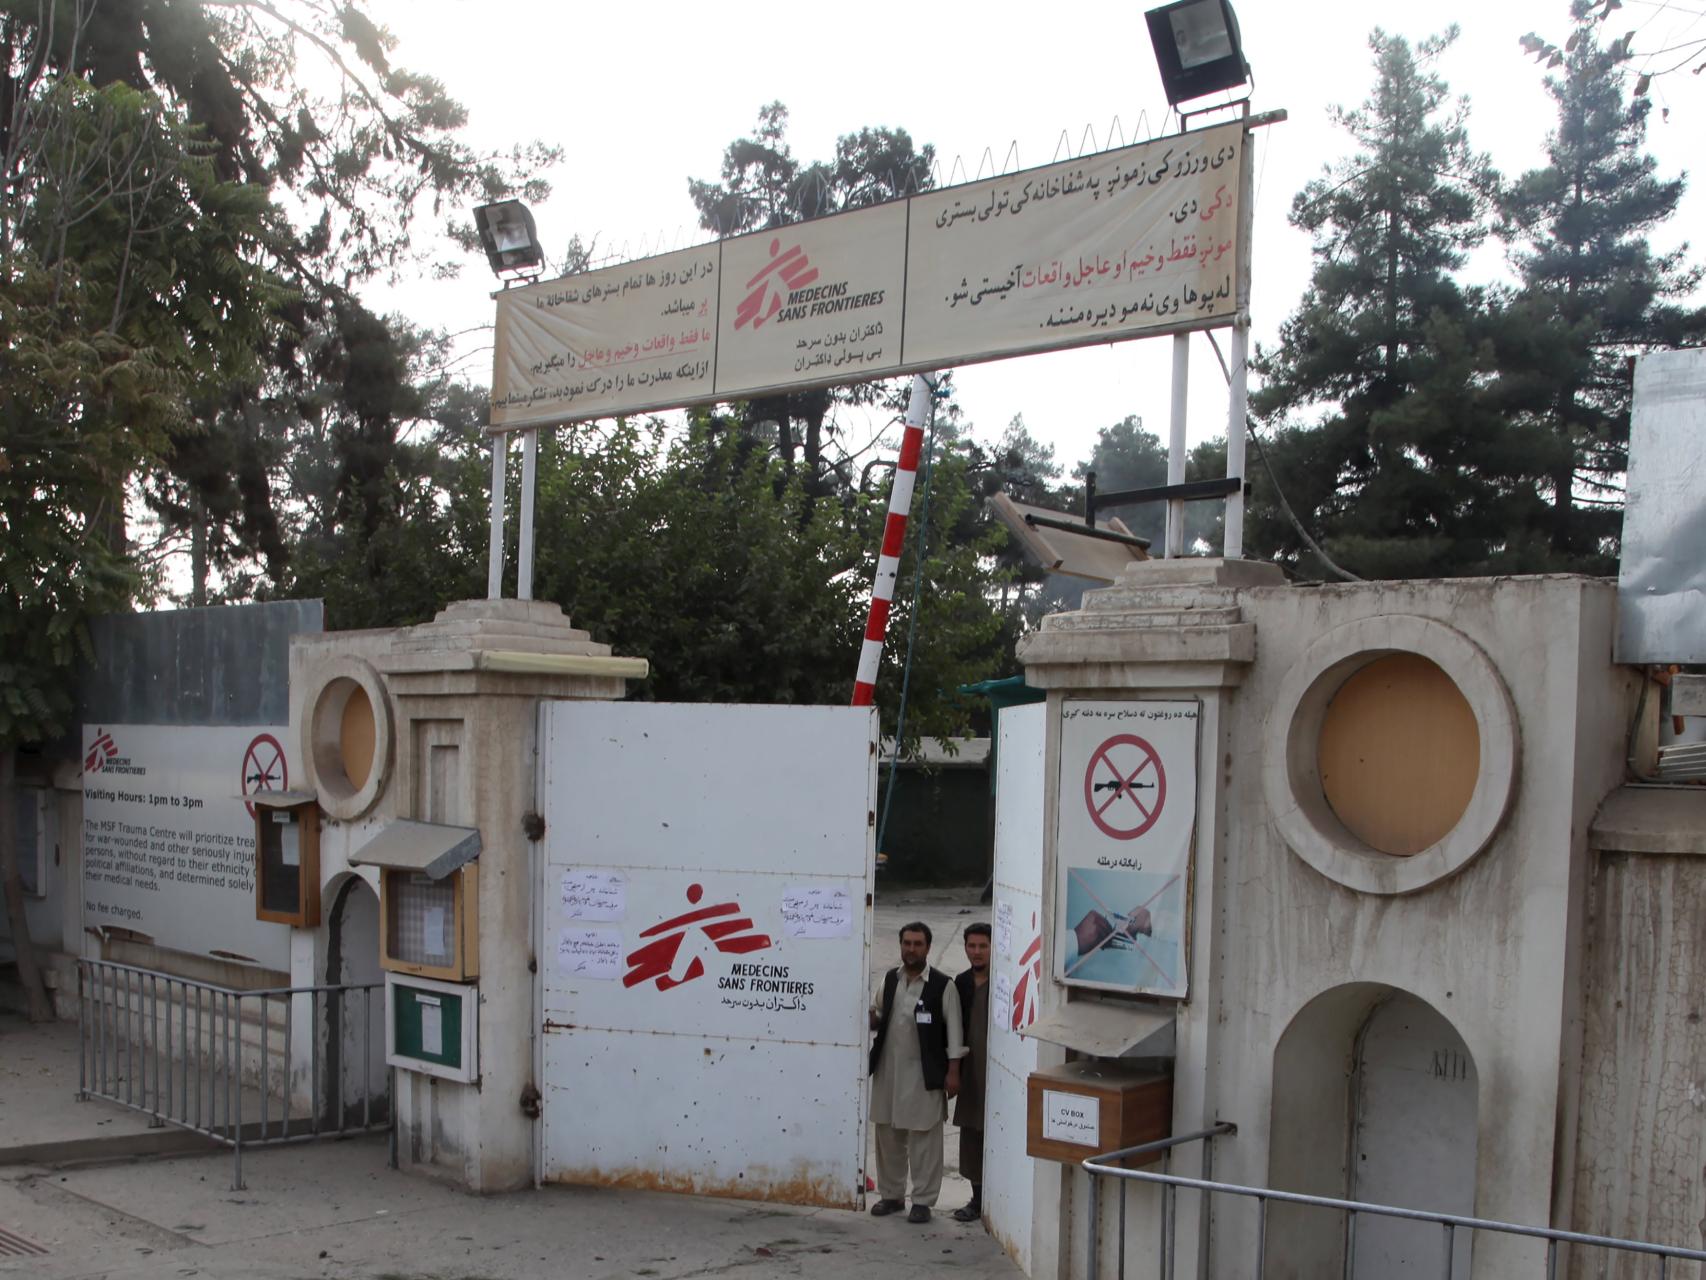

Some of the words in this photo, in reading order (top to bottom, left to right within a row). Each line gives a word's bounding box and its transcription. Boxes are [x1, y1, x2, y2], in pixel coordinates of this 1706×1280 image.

[1167, 234, 1197, 262] فقط
[679, 262, 698, 283] این
[700, 260, 713, 279] در
[1022, 260, 1071, 288] واقعات
[622, 278, 642, 296] تمام
[646, 274, 656, 287] ها
[659, 271, 676, 287] روز
[1215, 273, 1230, 299] له
[787, 281, 849, 306] MEDECINS
[535, 296, 545, 310] ما
[776, 305, 808, 323] SANS
[810, 289, 886, 317] FRONTIERES
[642, 335, 676, 352] واقعات
[679, 328, 699, 346] فقط
[701, 328, 711, 341] ما
[824, 331, 847, 347] بدون
[796, 338, 822, 350] سرحد
[578, 347, 604, 369] عاجل
[626, 374, 635, 387] ما
[638, 368, 673, 386] معذرت
[106, 757, 132, 766] MEDECINS
[115, 766, 146, 776] FRONTIERES
[85, 788, 116, 803] Visiting
[118, 790, 146, 804] Hours:
[149, 793, 168, 806] 1pm
[170, 795, 180, 807] to
[182, 796, 203, 810] 3pm
[85, 819, 99, 831] The
[101, 820, 116, 832] MSF
[118, 822, 147, 836] Trauma
[149, 826, 177, 840] Centre
[178, 829, 193, 841] will
[195, 831, 234, 846] prioritize
[85, 832, 96, 843] for
[97, 833, 148, 849] war-wounded
[150, 841, 165, 852] and
[167, 842, 190, 855] other
[192, 846, 231, 861] seriously
[118, 849, 146, 862] without
[149, 855, 175, 867] regard
[178, 858, 186, 868] to
[188, 858, 209, 871] their
[211, 861, 250, 878] ethnicity
[86, 858, 113, 870] political
[115, 860, 157, 879] affiliations,
[159, 868, 175, 880] and
[176, 871, 225, 888] determined
[228, 879, 254, 894] solely
[86, 871, 103, 881] their
[104, 873, 133, 886] medical
[135, 879, 161, 892] needs.
[86, 900, 96, 912] No
[98, 902, 109, 914] fee
[111, 904, 144, 921] charged.
[731, 963, 790, 979] MEDECINS
[717, 976, 746, 991] SANS
[750, 978, 814, 995] FRONTIERES
[742, 998, 765, 1012] بدون
[1061, 1108, 1069, 1116] CV
[1071, 1110, 1084, 1118] BOX
